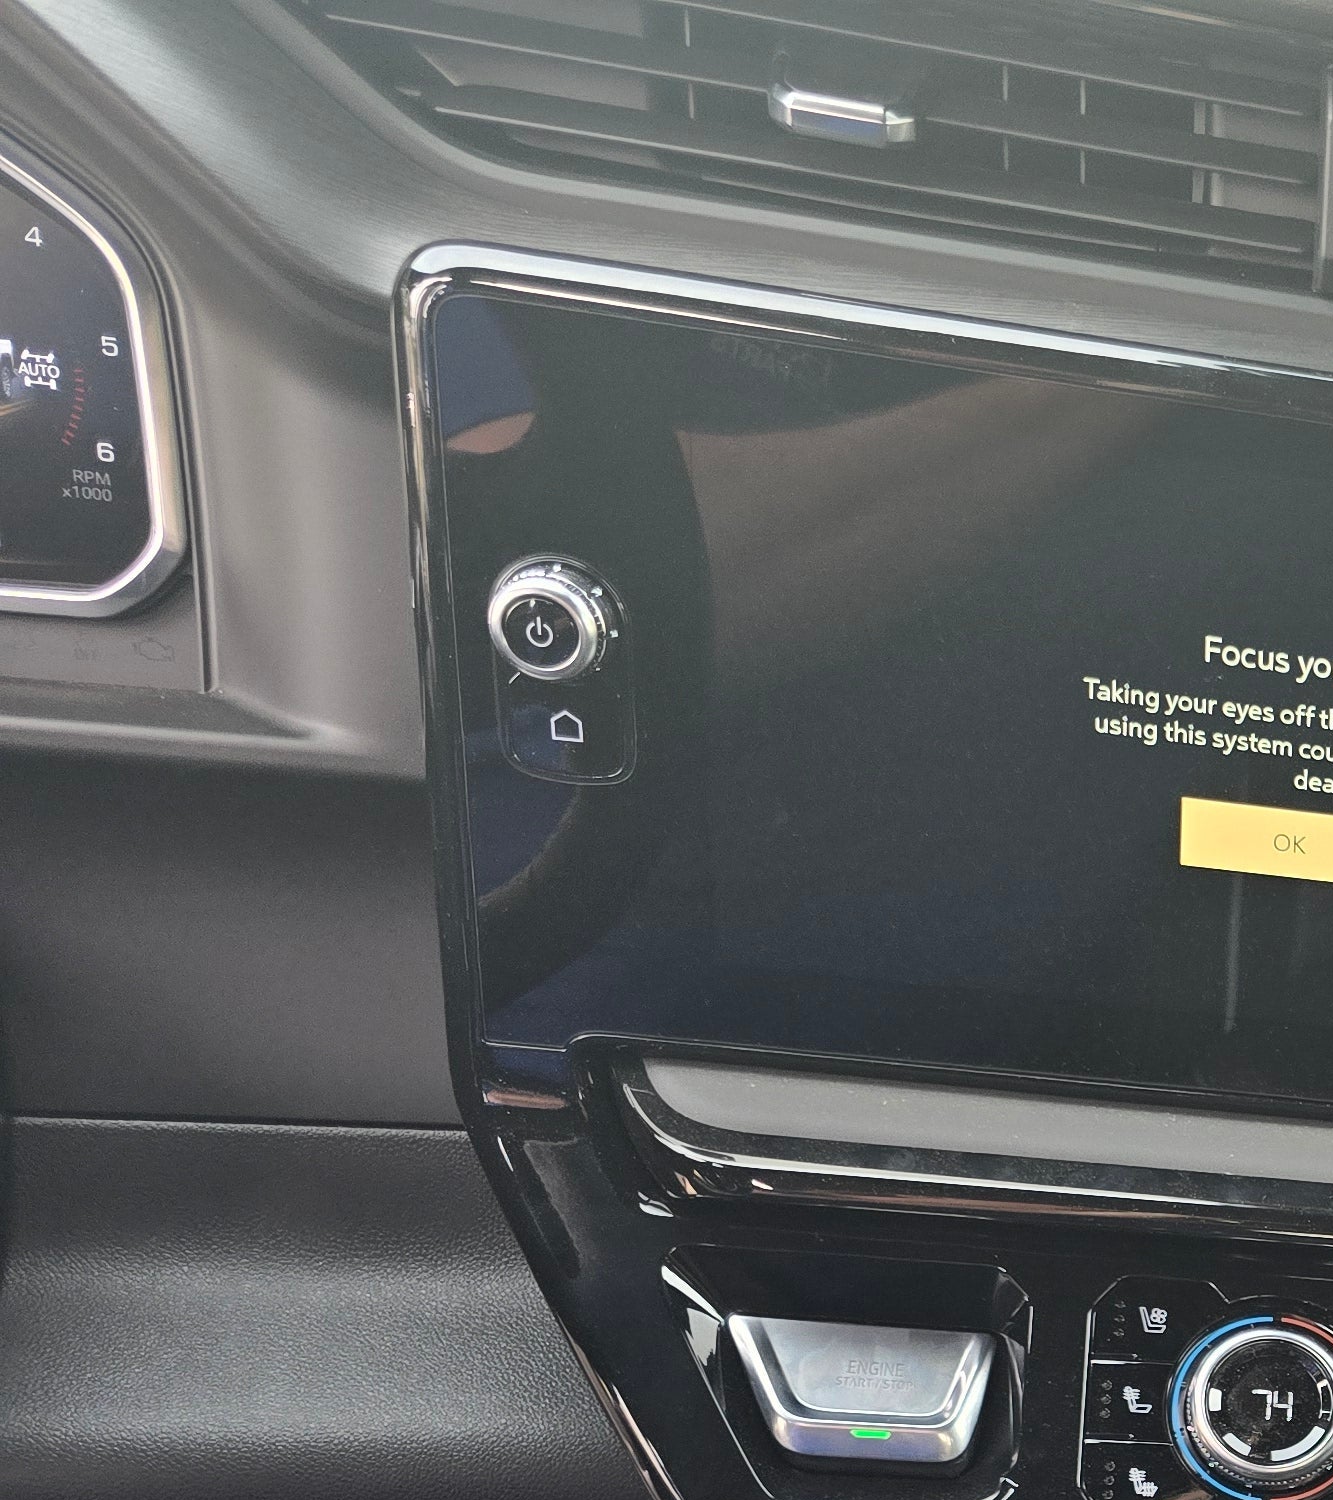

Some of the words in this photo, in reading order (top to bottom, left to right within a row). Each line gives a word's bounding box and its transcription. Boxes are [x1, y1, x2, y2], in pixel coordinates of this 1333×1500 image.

[24, 226, 43, 247] 4
[101, 335, 119, 357] 5
[18, 364, 60, 380] AUTO
[96, 442, 116, 463] 6
[72, 469, 112, 486] RPM
[62, 486, 113, 502] x1000
[1204, 635, 1290, 674] Focus
[1083, 676, 1159, 714] Taking
[1164, 693, 1218, 716] your
[1222, 701, 1274, 724] eyes
[1280, 704, 1317, 728] off
[1094, 715, 1158, 746] using
[1163, 720, 1207, 746] this
[1212, 731, 1293, 758] system
[1273, 833, 1307, 855] OK
[847, 1360, 905, 1377] ENGINE
[1252, 1389, 1294, 1421] 74
